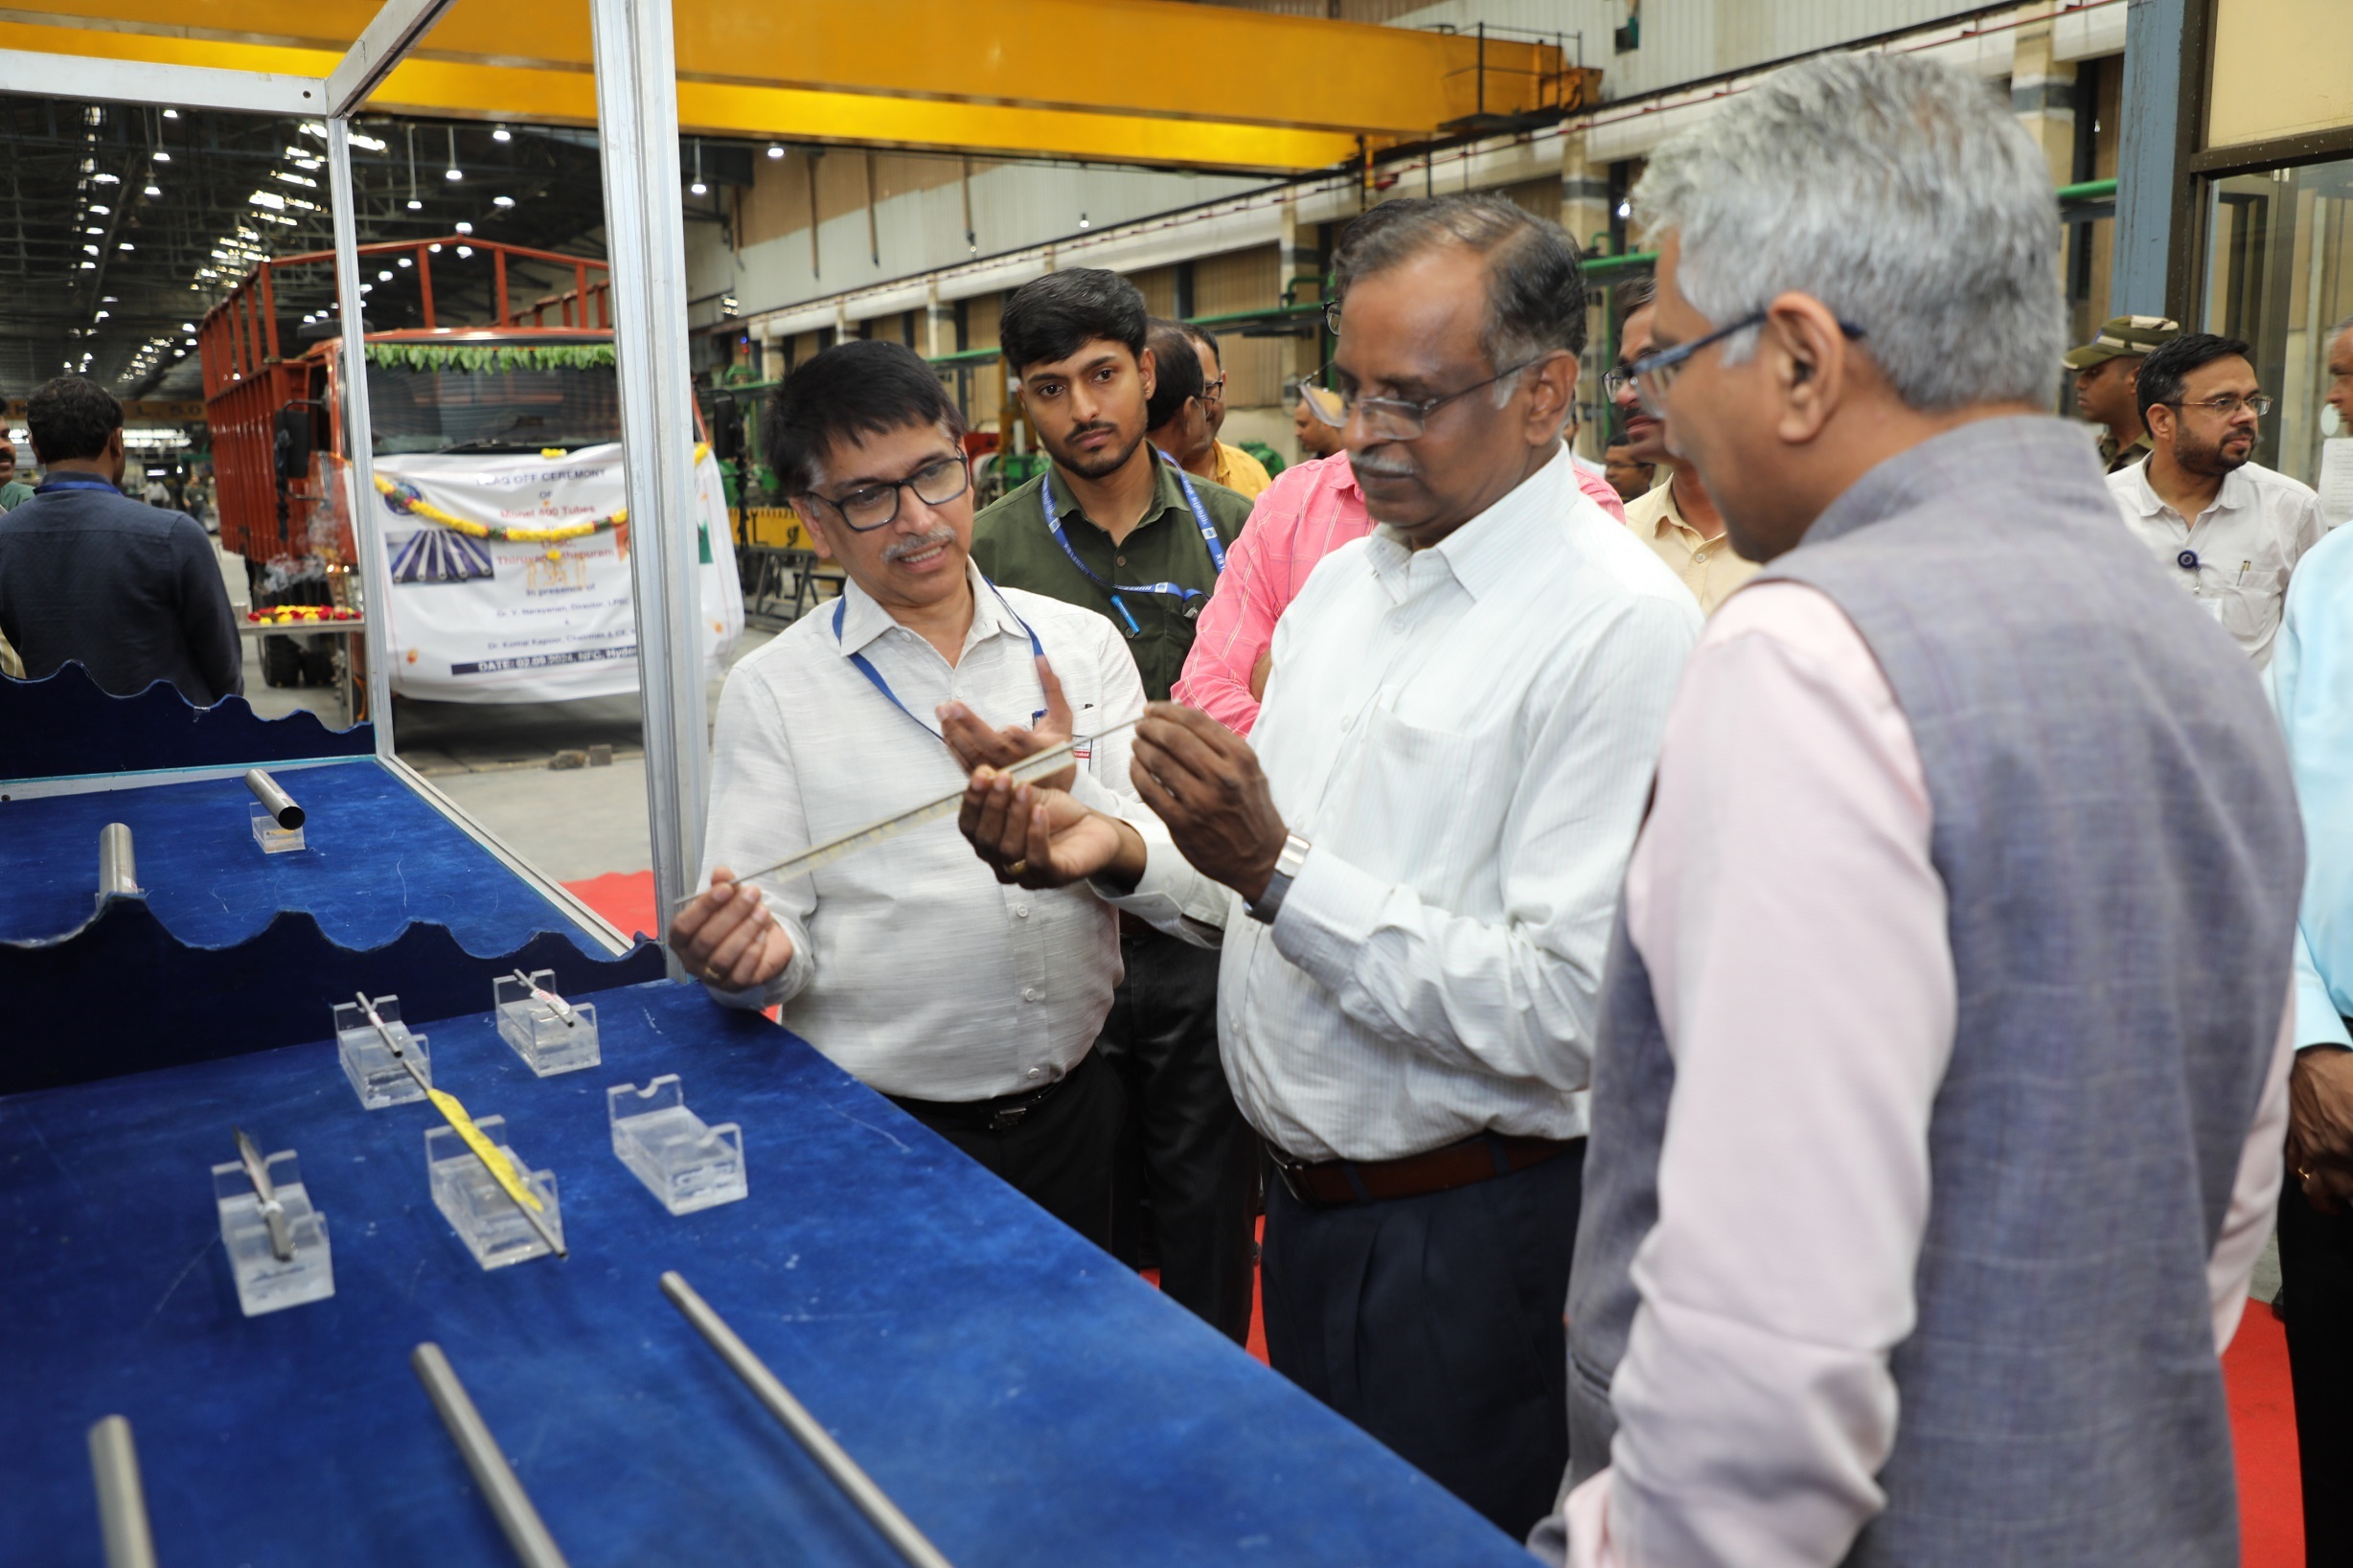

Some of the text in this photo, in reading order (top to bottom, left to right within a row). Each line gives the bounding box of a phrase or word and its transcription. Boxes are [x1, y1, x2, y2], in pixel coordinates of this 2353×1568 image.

[514, 473, 537, 486] OFF
[541, 467, 605, 483] CEREMONY
[562, 504, 596, 515] Tubes
[538, 583, 582, 597] presence
